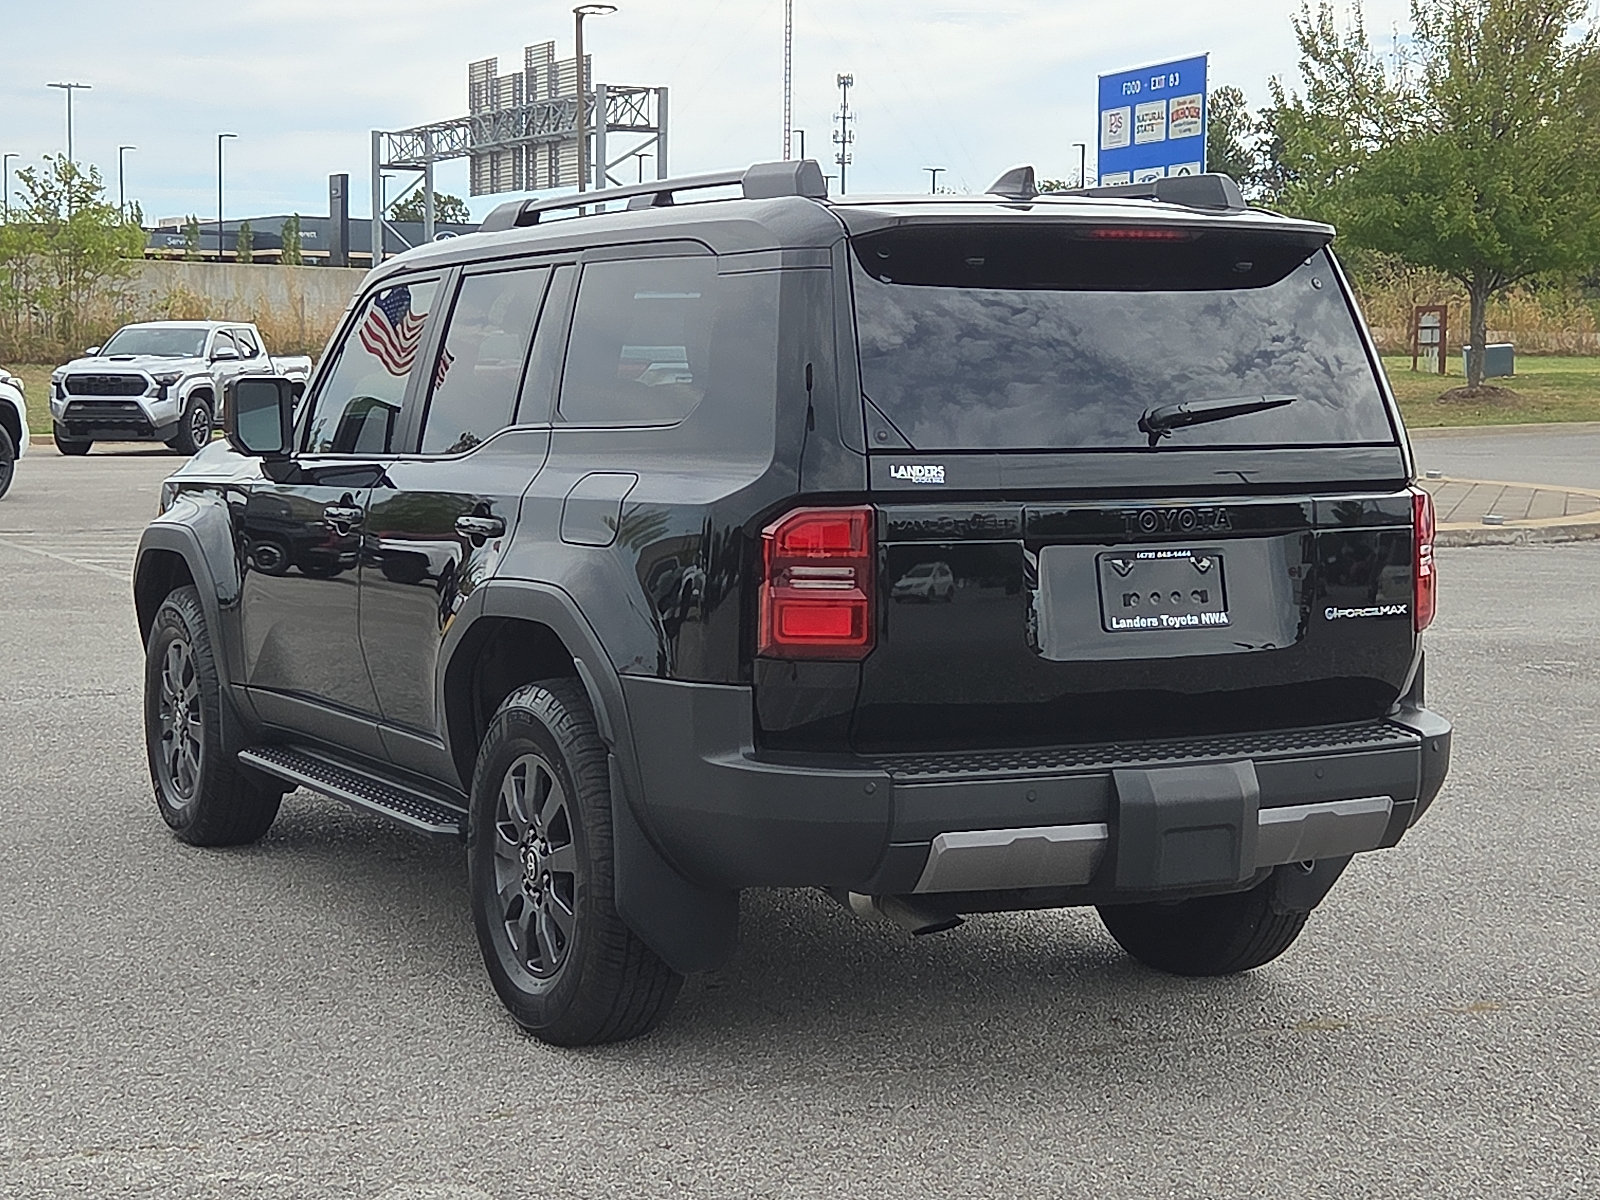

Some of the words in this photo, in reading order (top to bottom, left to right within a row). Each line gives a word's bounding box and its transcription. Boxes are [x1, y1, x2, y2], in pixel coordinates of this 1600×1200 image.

[1122, 80, 1141, 95] FOOD
[1150, 75, 1166, 90] EXIT
[1136, 111, 1165, 123] NATURAL
[1136, 123, 1156, 134] STATE
[890, 465, 945, 479] LANDERS
[1121, 507, 1233, 533] TOYOTA
[1111, 615, 1159, 629] Landers
[1160, 614, 1199, 628] Toyota
[1200, 612, 1229, 625] NWA
